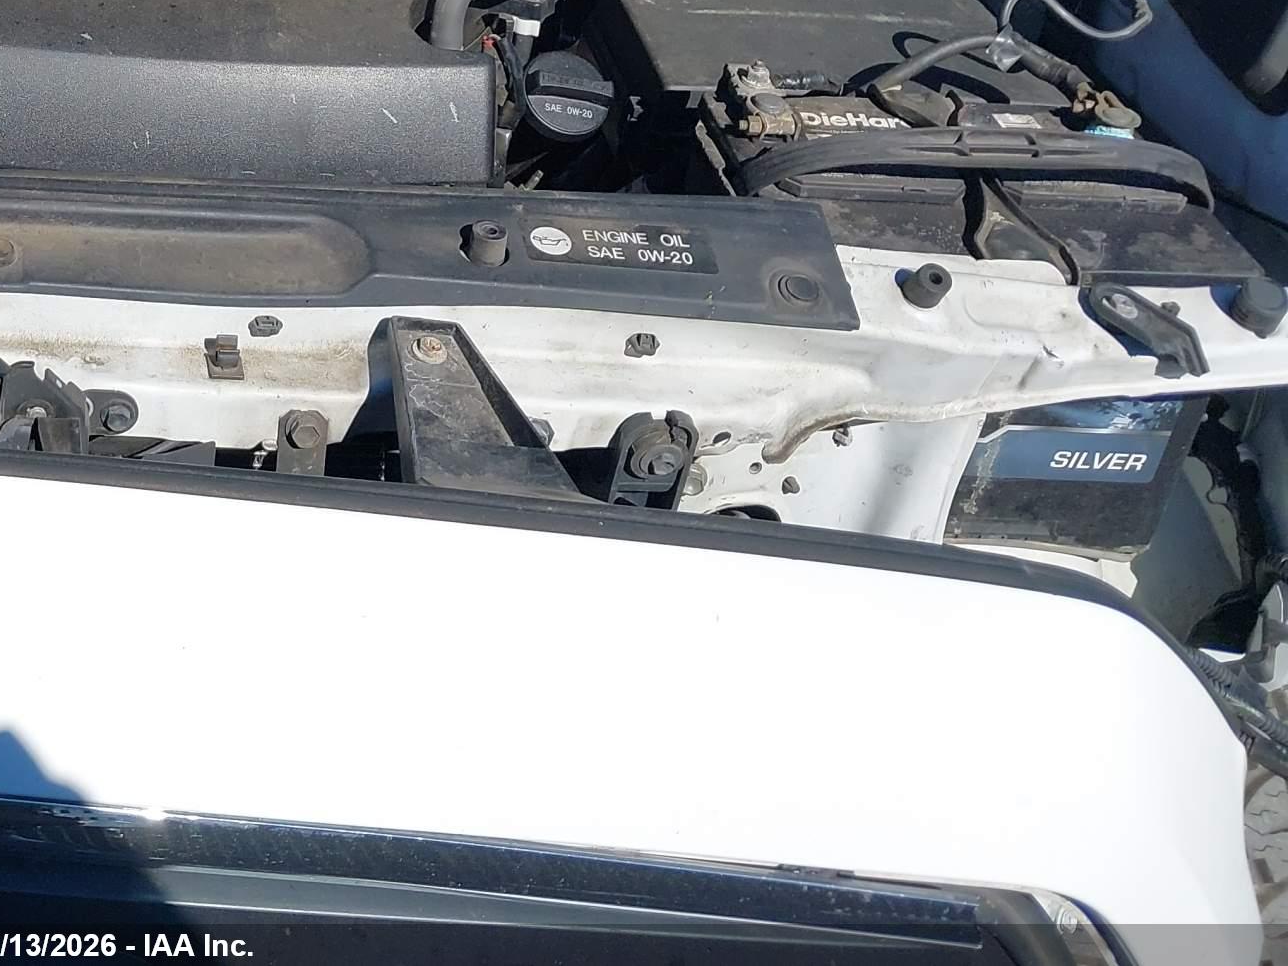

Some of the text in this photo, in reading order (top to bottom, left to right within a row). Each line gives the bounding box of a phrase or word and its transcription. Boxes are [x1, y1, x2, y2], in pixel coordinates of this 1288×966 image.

[544, 102, 594, 119] SAE 0W-20
[799, 111, 912, 130] DieHar
[581, 228, 691, 248] ENGINE OIL
[587, 246, 694, 265] SAE 0W-20
[1049, 450, 1148, 471] SILVER
